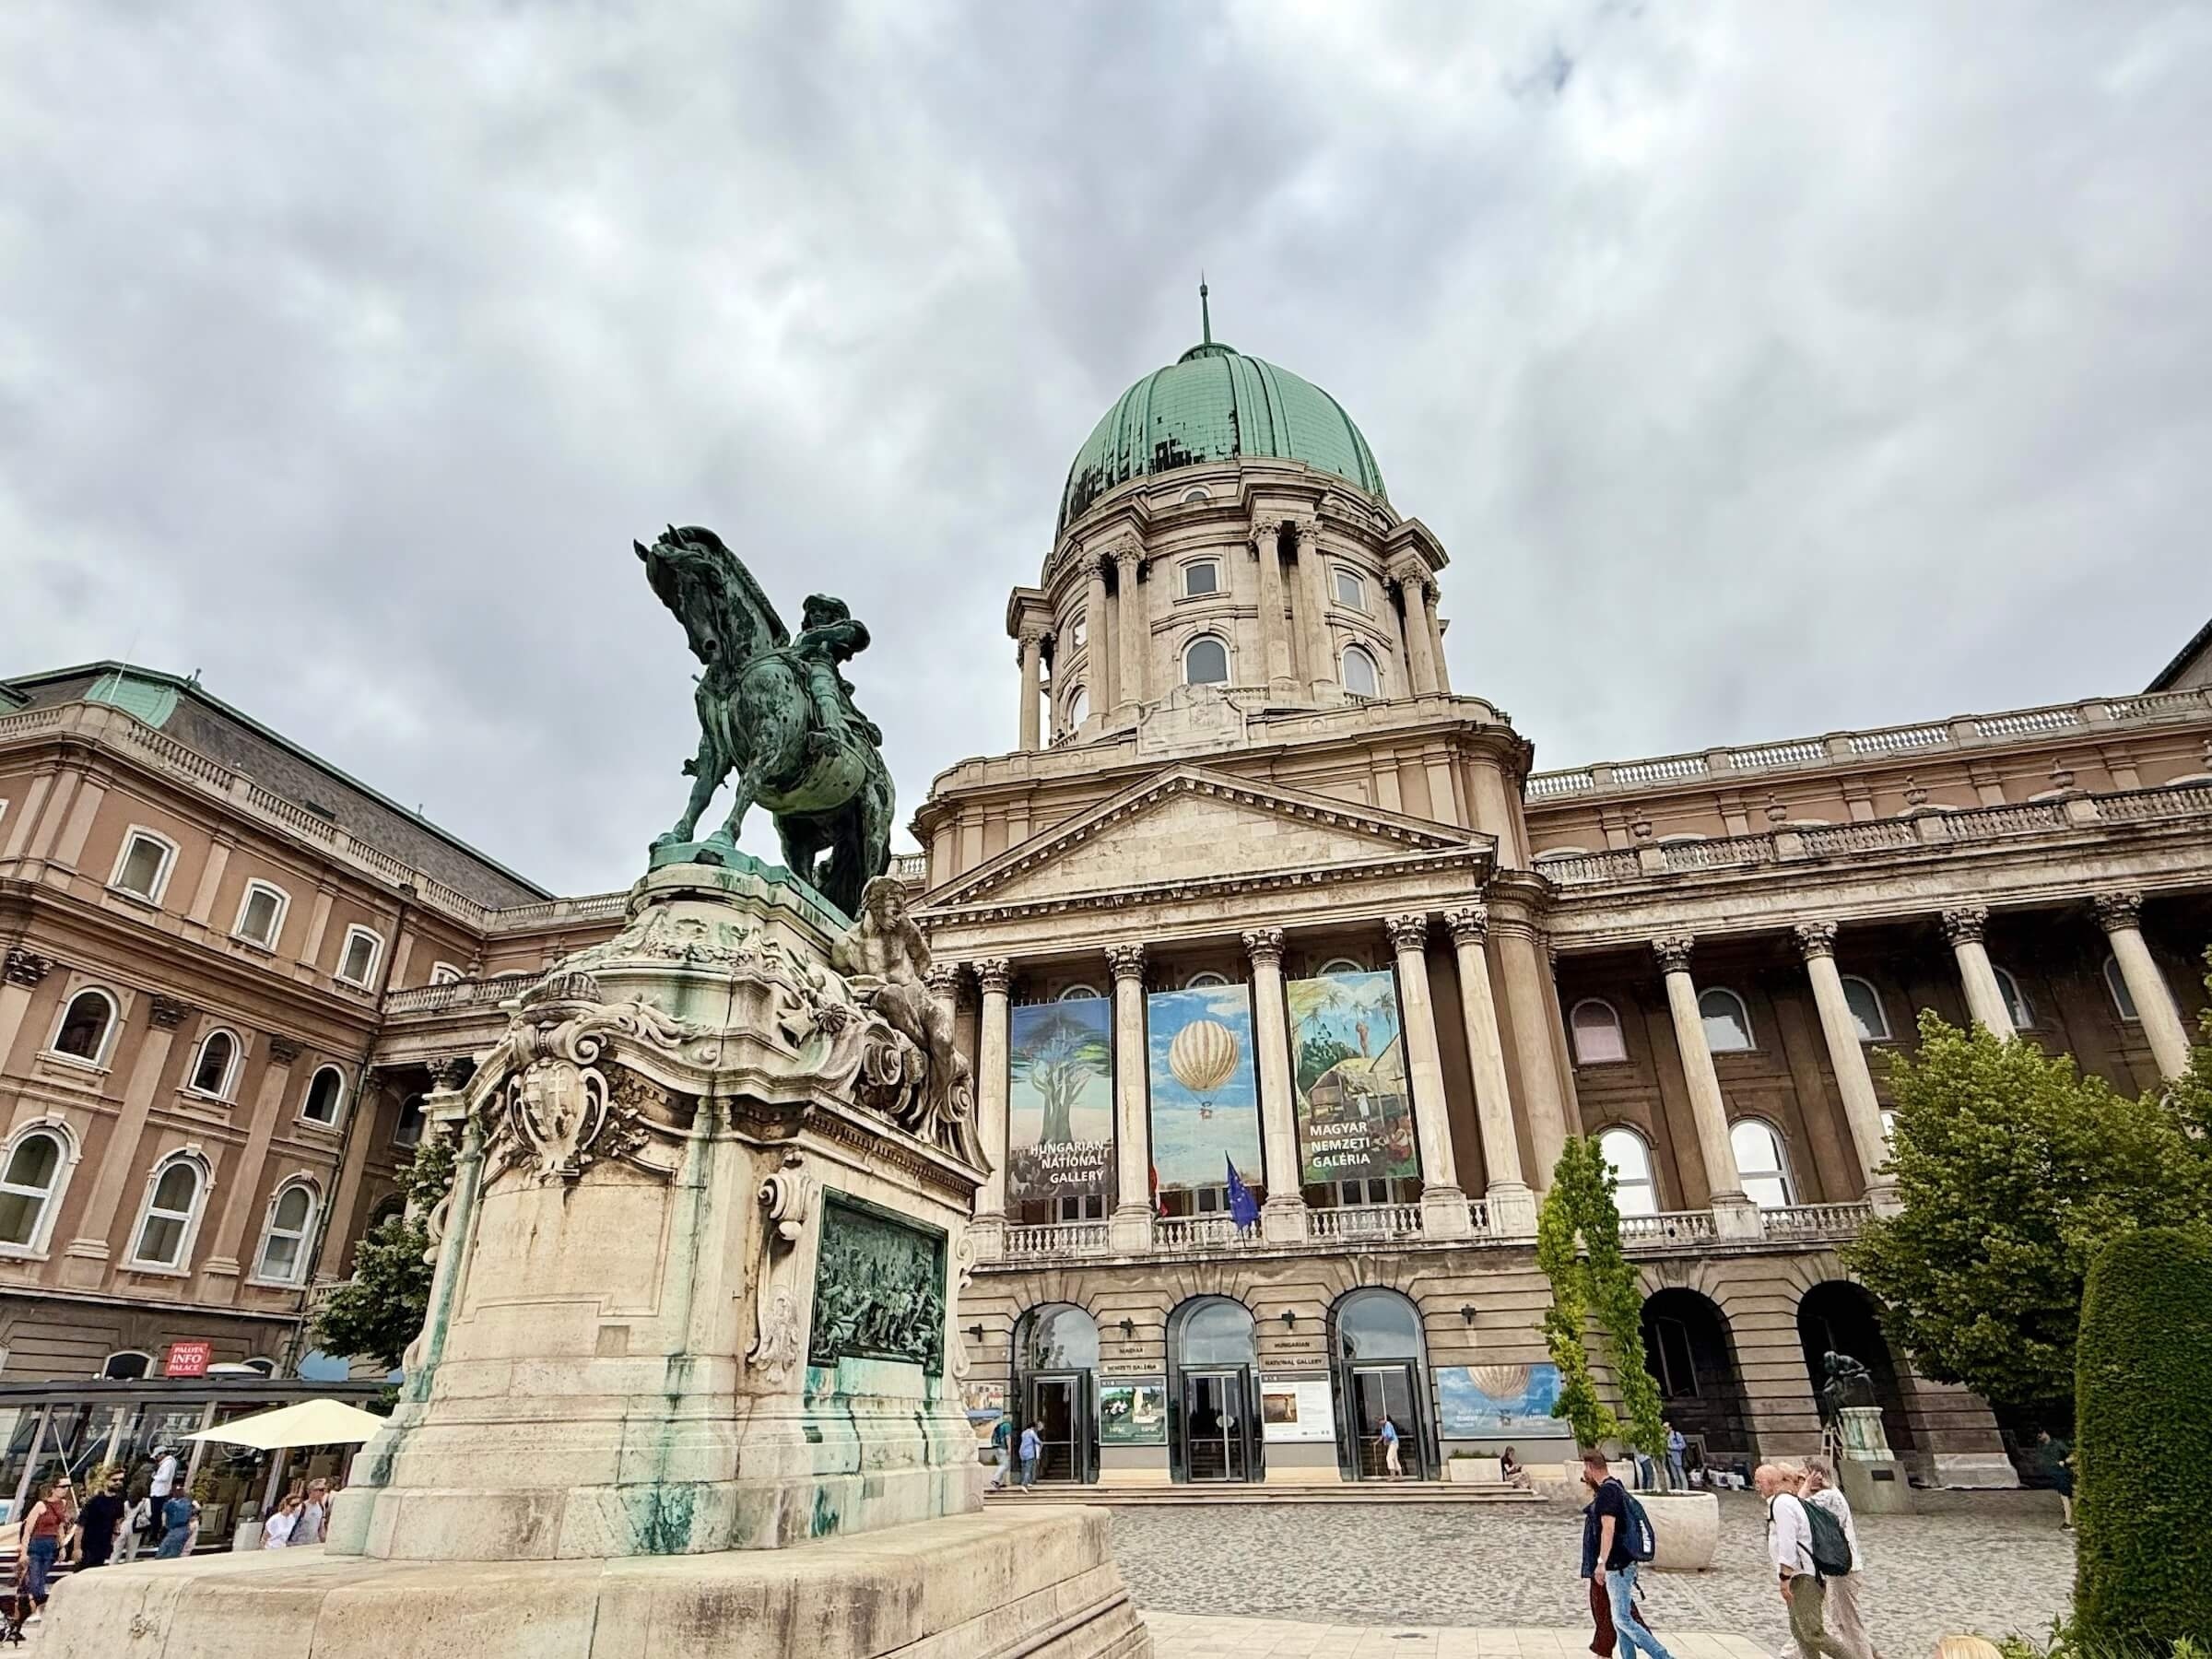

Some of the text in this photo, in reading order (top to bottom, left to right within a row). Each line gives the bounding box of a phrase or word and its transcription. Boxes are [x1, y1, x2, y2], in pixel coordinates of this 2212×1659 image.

[1310, 1122, 1368, 1136] MAGYAR
[1030, 1140, 1104, 1156] HUNGARIAN
[1311, 1136, 1371, 1152] NEMZETI
[1041, 1155, 1104, 1170] NATIONAL
[1312, 1152, 1371, 1168] GALÉRIA
[1050, 1170, 1104, 1183] GALLERY
[171, 1354, 202, 1364] INFO
